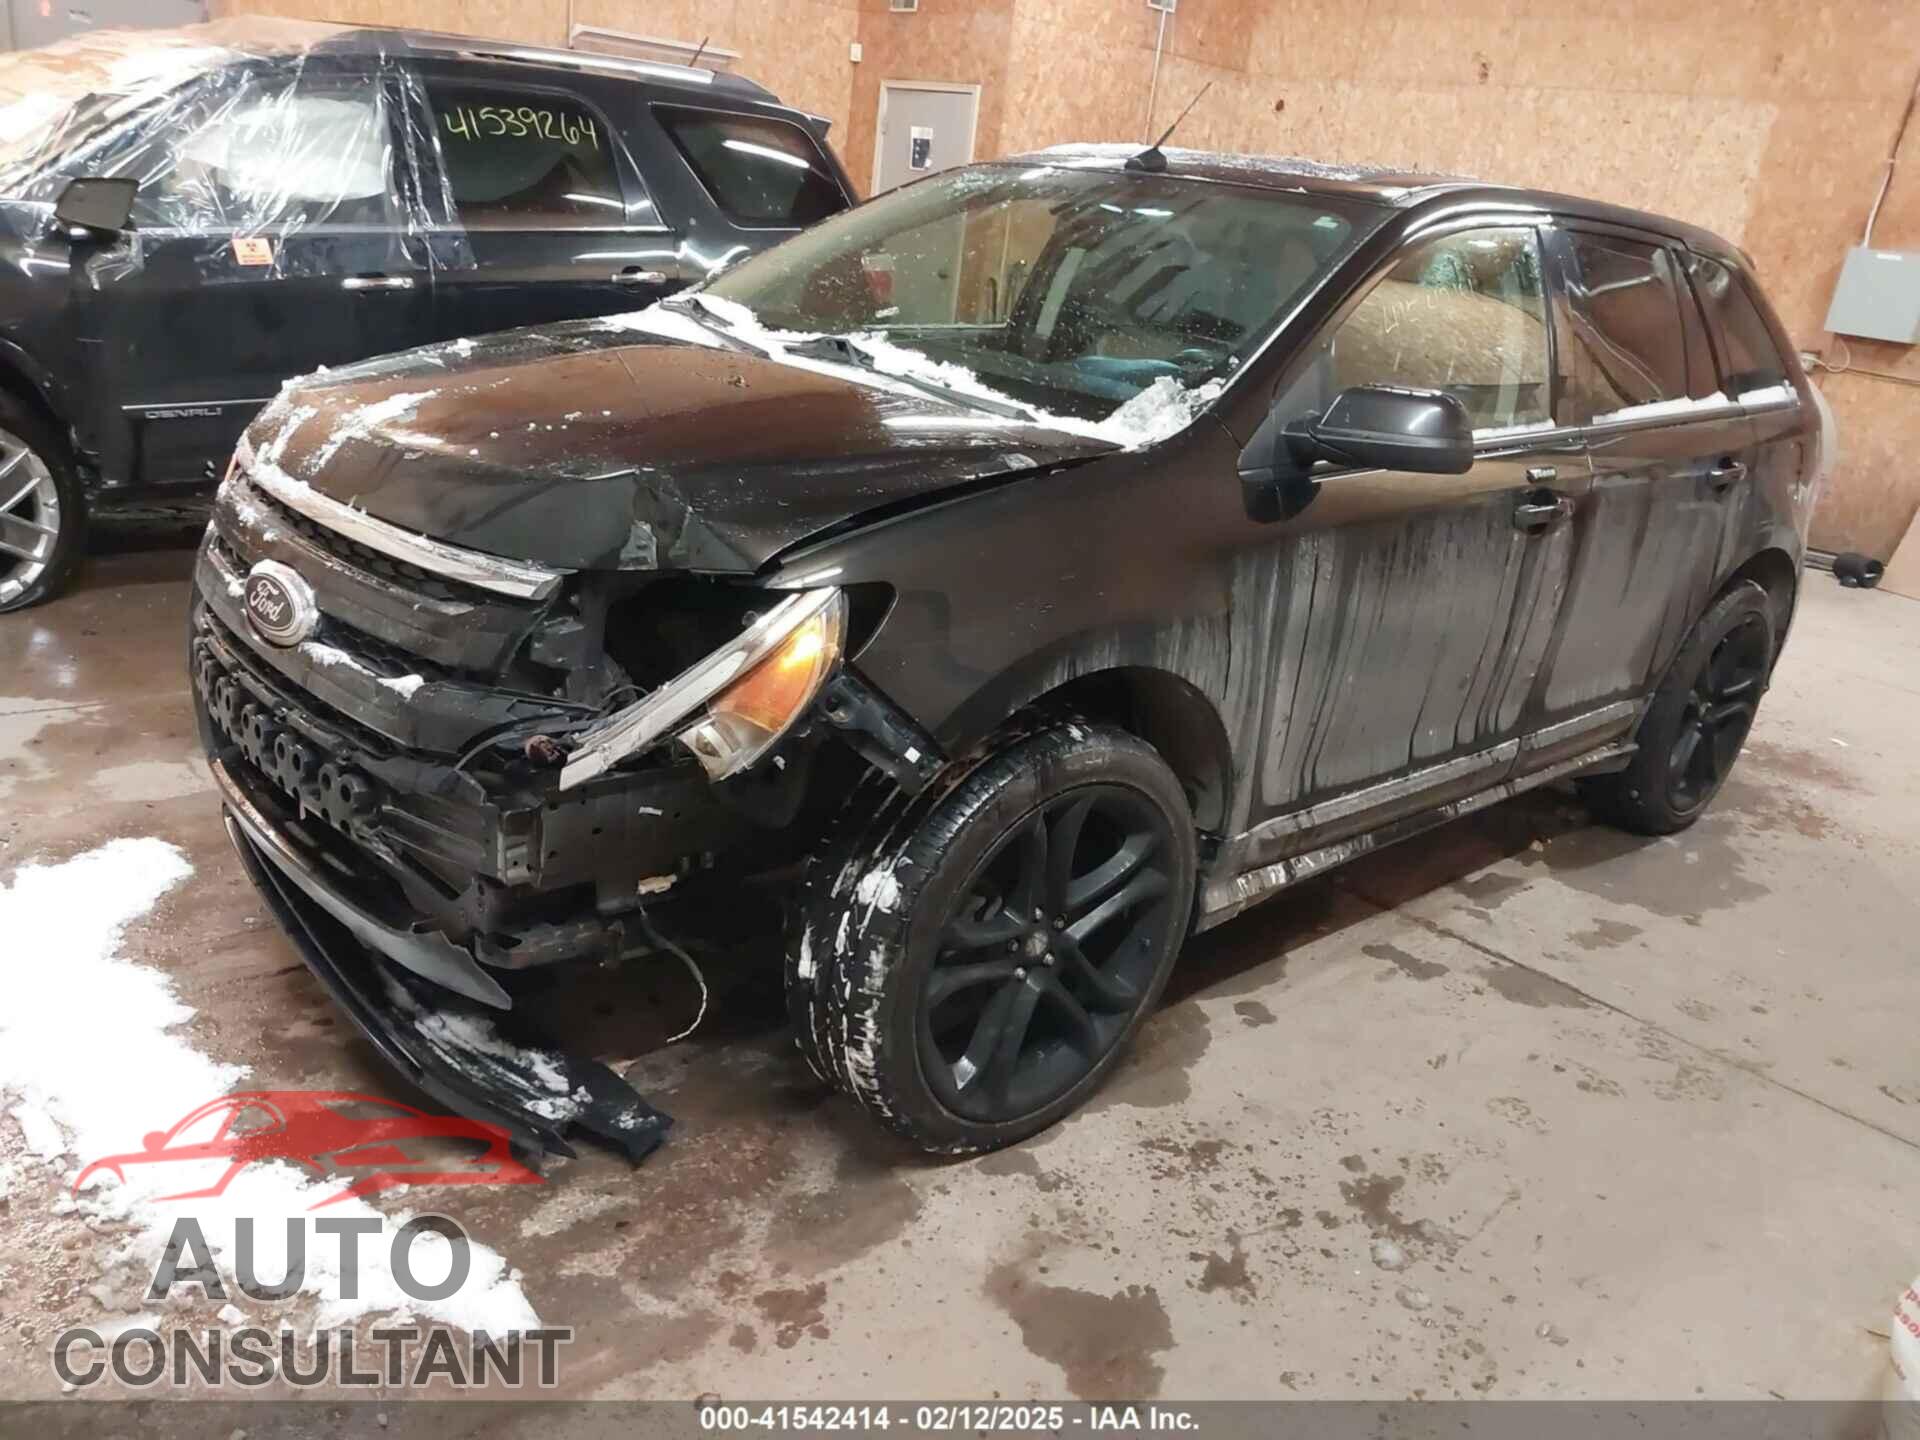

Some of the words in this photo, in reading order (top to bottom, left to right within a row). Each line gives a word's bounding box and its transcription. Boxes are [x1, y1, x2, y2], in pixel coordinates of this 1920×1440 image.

[444, 107, 599, 150] 41539264
[145, 407, 222, 419] DENALI
[250, 579, 284, 622] Ford
